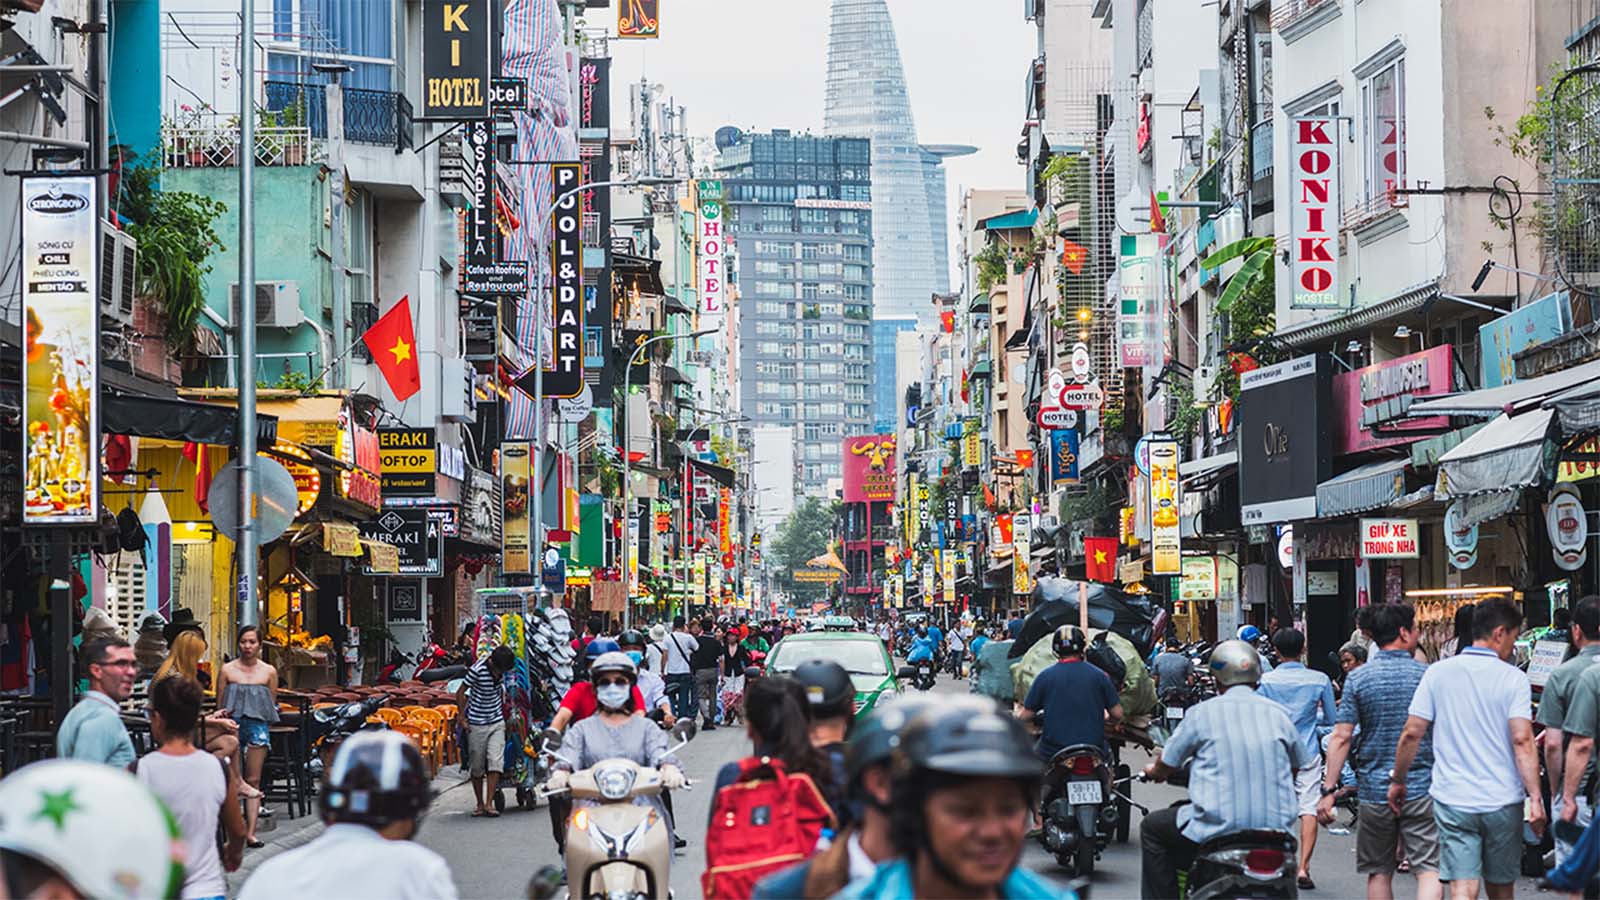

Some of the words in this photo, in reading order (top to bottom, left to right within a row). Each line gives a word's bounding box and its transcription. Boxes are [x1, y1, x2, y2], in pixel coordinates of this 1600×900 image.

[428, 79, 484, 107] HOTEL
[490, 85, 519, 102] otel
[31, 199, 83, 209] STRONGBOW
[704, 205, 718, 215] 94
[1296, 120, 1335, 292] KONIKO
[467, 265, 486, 275] Cafe
[495, 265, 524, 277] Rooftop
[704, 222, 719, 311] HOTEL
[468, 282, 524, 291] Restaurant
[1295, 294, 1337, 305] HOSTEL
[1067, 392, 1100, 401] HOTEL
[379, 432, 427, 446] ERAKI
[380, 455, 427, 467] OFTOP
[1057, 441, 1075, 474] Tiger
[1392, 524, 1407, 537] XE
[365, 532, 419, 544] MERAKI
[1364, 541, 1393, 554] TRONG
